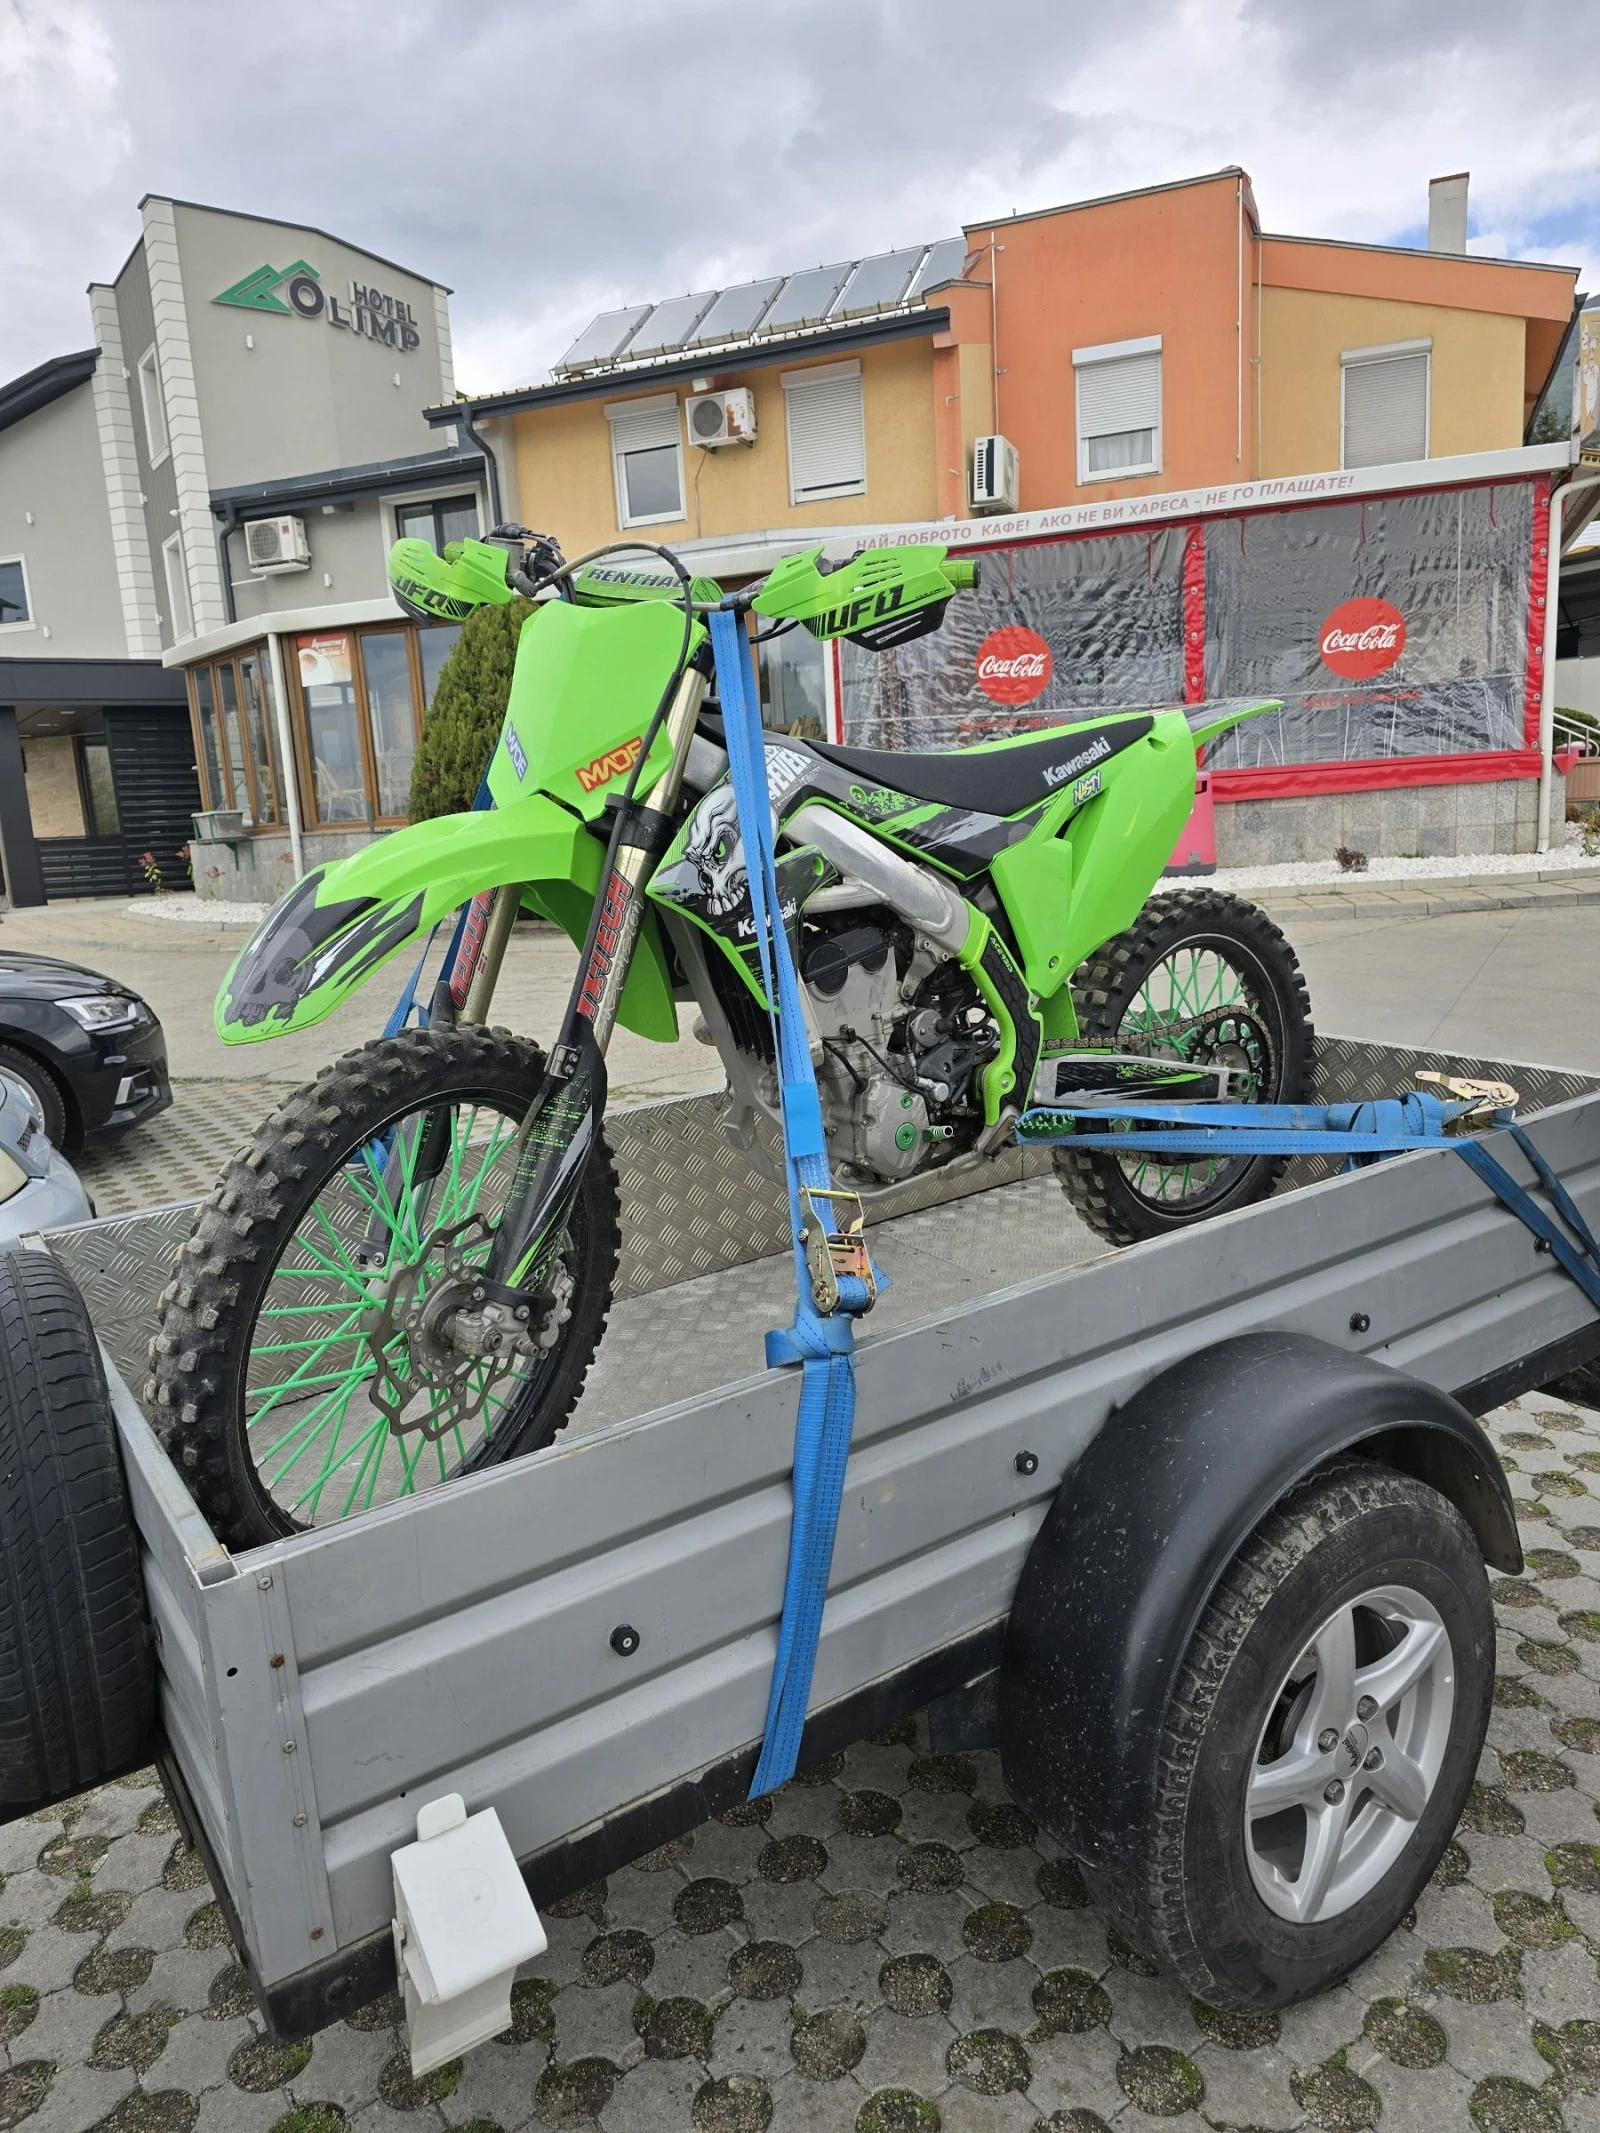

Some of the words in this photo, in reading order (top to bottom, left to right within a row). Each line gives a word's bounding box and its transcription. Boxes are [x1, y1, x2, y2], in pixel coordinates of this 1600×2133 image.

[288, 276, 421, 351] OLIMP
[349, 281, 417, 327] HOTEL
[856, 526, 972, 550] НАЙ-ДОБРОТО
[981, 519, 1030, 537] КАФЕ!
[1039, 513, 1072, 529] АКО
[1077, 510, 1097, 523] НЕ
[1102, 506, 1123, 520] ВИ
[1128, 497, 1189, 517] ХАРЕСА
[1206, 490, 1227, 505] НЕ
[1233, 486, 1254, 501] ГО
[1260, 475, 1354, 497] ПЛАЩАТЕ!
[396, 575, 449, 609] UFO
[587, 568, 684, 588] RENTHAL
[827, 583, 905, 634] UFO
[1322, 623, 1401, 654] Coca-Cola
[978, 653, 1048, 679] Coca-Cola
[506, 725, 527, 780] MADE
[578, 739, 644, 790] MADE
[1042, 736, 1111, 787] Kawasaki
[1073, 769, 1101, 805] NASTY
[737, 897, 797, 938] Kaaki
